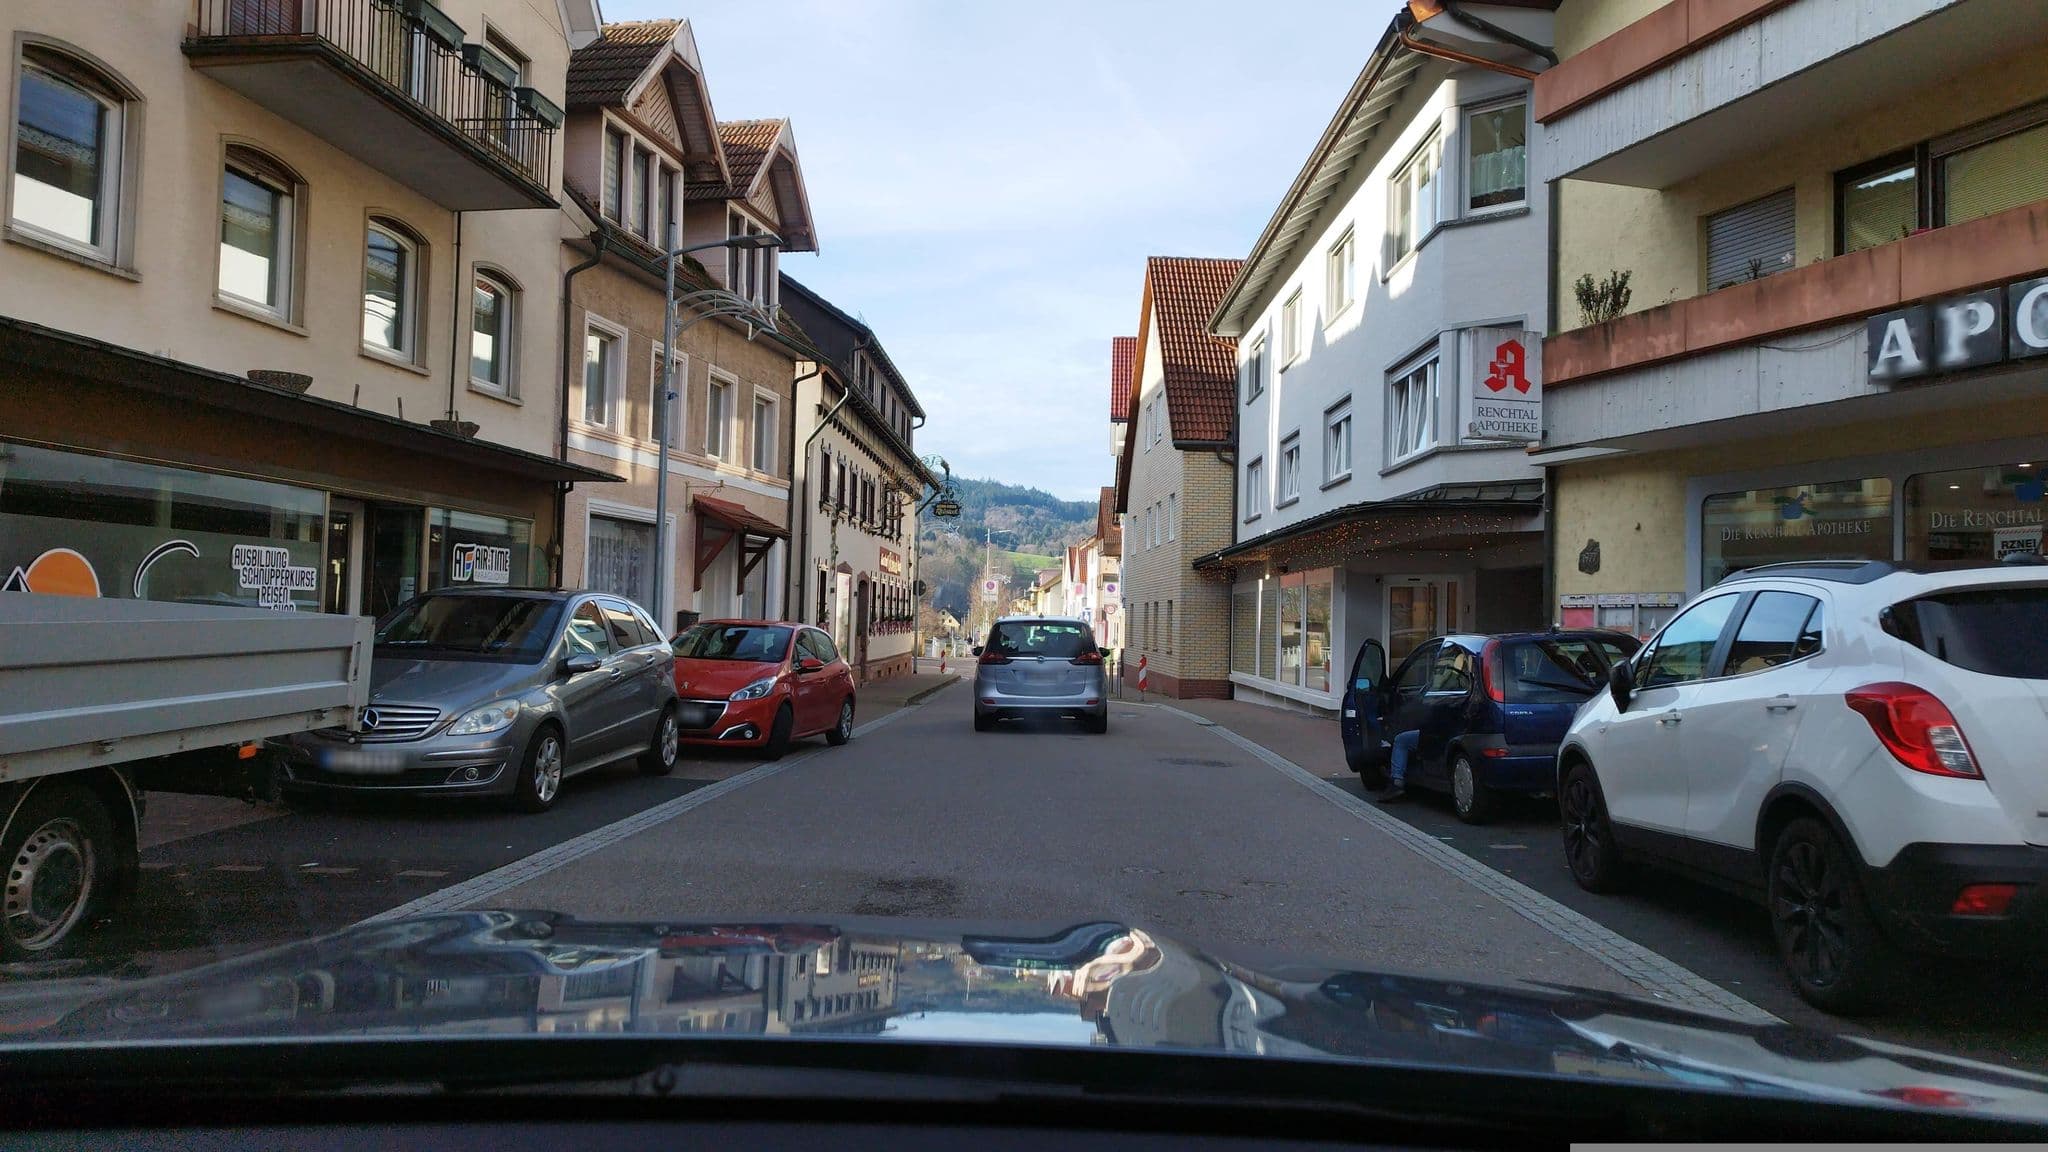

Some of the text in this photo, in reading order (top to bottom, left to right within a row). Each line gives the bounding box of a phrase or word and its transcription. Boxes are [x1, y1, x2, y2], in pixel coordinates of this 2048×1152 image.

[1478, 406, 1538, 420] RENCHTAL
[1478, 420, 1538, 433] APOTHEKE
[1963, 508, 2043, 526] RENCHTAL
[1807, 520, 1871, 536] APOTHEKE
[234, 548, 287, 569] AUSBILDUNG
[241, 567, 315, 587] SCHNUPPERKURSE
[261, 586, 289, 603] REISEN
